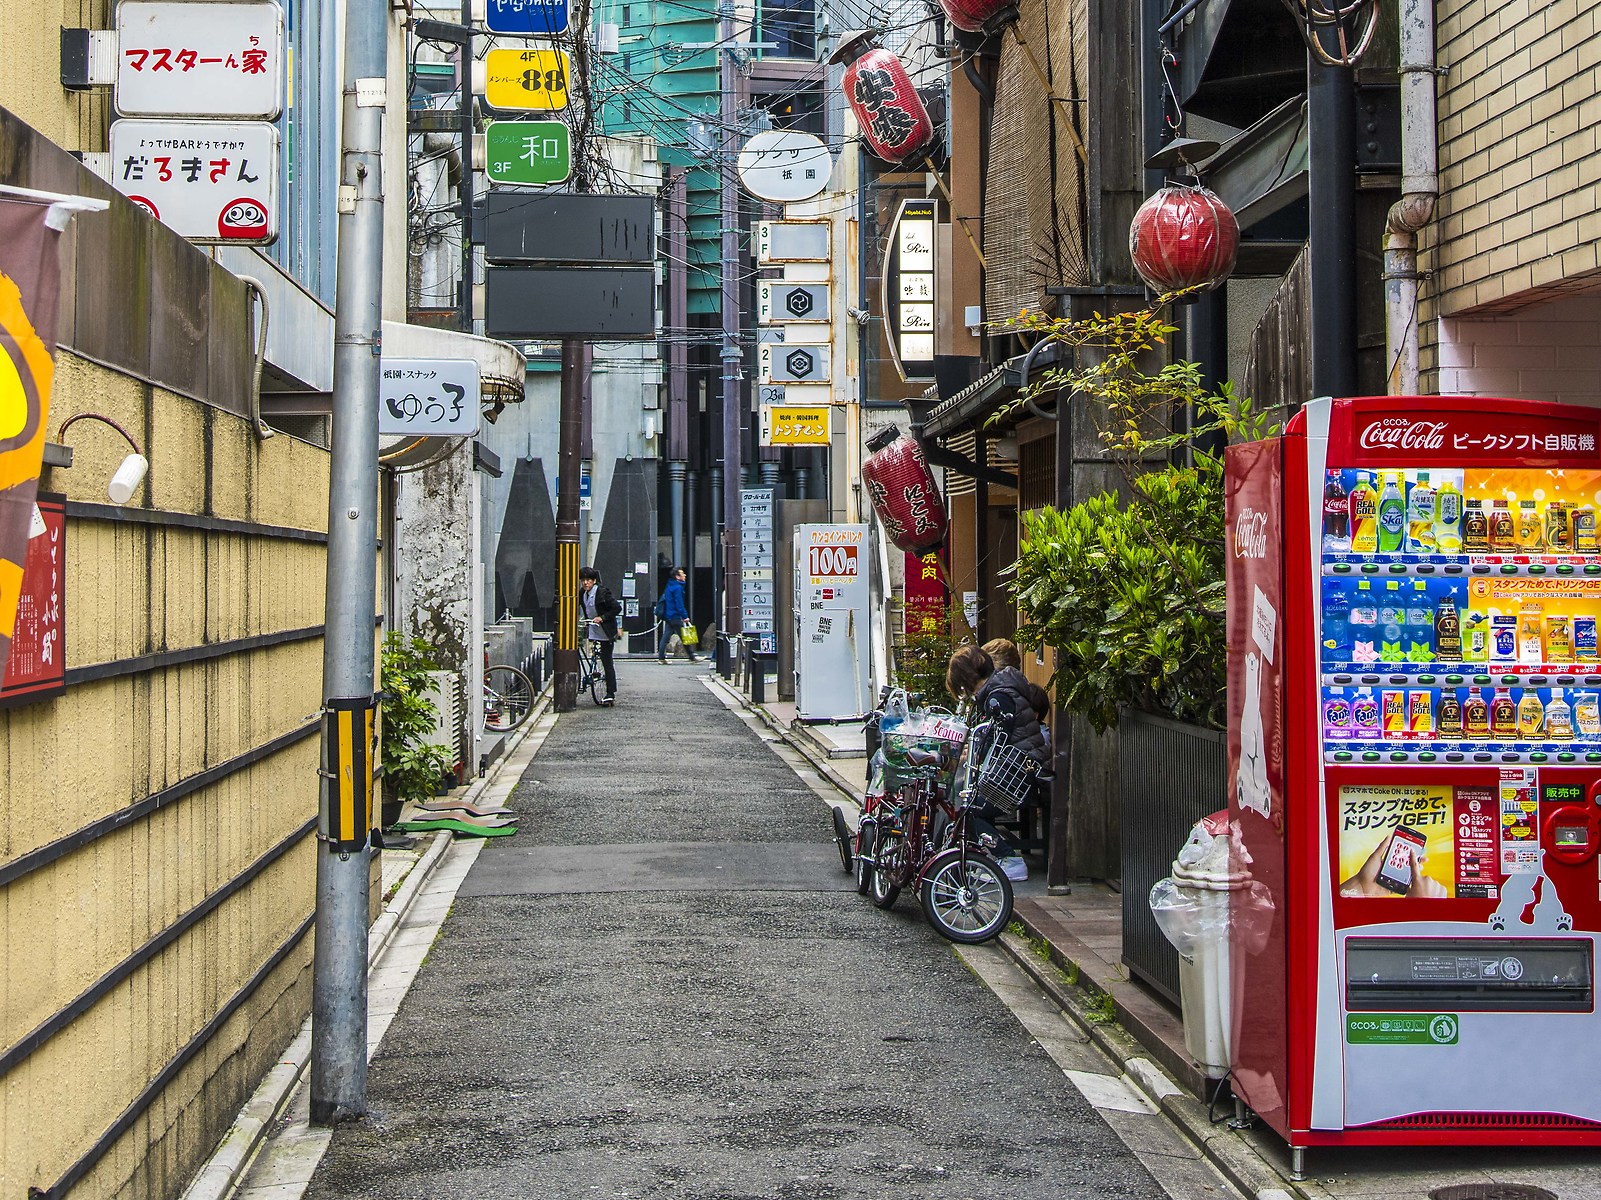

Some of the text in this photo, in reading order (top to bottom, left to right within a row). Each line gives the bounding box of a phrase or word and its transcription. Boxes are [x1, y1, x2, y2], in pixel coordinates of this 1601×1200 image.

[125, 48, 268, 74] マスターん家
[520, 51, 536, 62] 4F
[521, 69, 564, 92] 88
[520, 135, 558, 167] 和
[123, 156, 259, 184] だるまさん
[493, 161, 512, 173] 3F
[383, 369, 437, 379] 祇園・スナック
[386, 382, 465, 423] ゆう子
[1360, 421, 1595, 451] Coca-Cola ピークシフト自販機
[811, 530, 863, 544] ワンコインドリンク
[810, 547, 857, 575] 100円
[810, 602, 824, 610] BNE
[819, 617, 832, 626] BNE
[1546, 787, 1580, 798] 販売中
[1344, 797, 1446, 814] スタンプためて、
[1344, 811, 1446, 831] ドリンクGET!
